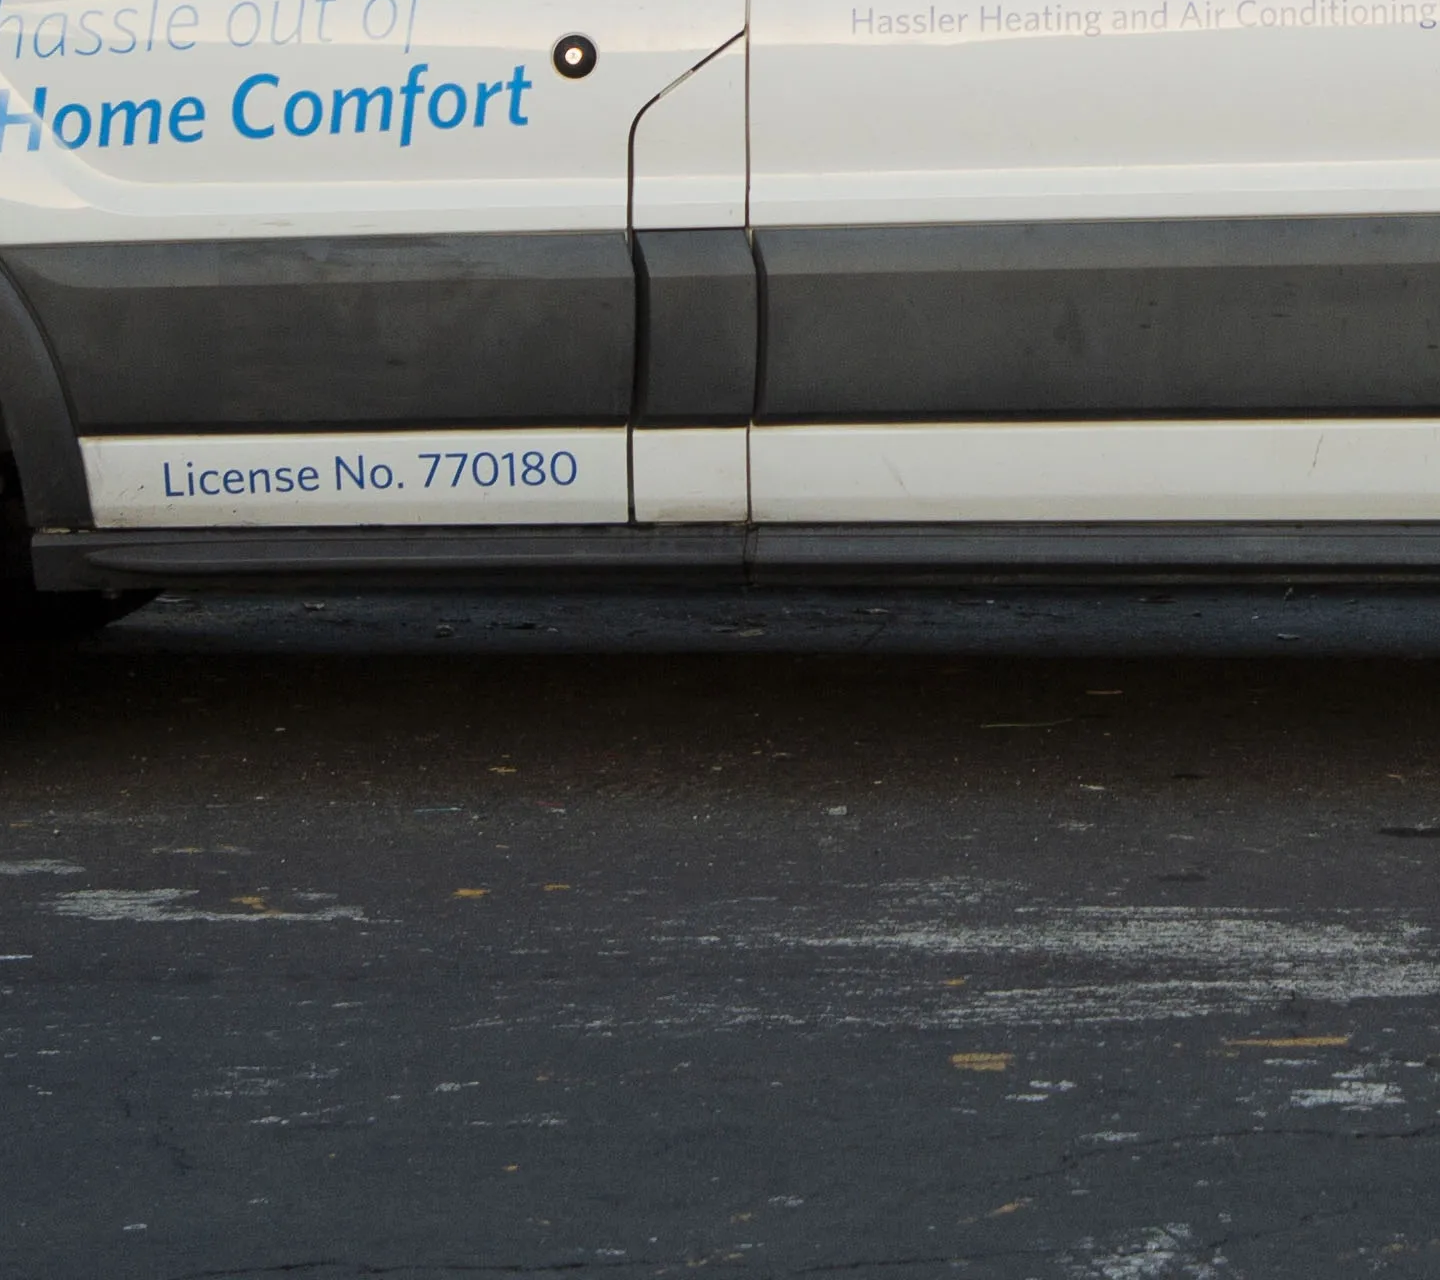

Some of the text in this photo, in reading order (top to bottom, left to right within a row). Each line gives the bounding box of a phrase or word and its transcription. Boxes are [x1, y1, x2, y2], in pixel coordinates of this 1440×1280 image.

[851, 3, 969, 36] Hassler
[980, 2, 1103, 38] Heating
[1112, 0, 1168, 31] and
[231, 63, 532, 148] Comfort
[163, 450, 578, 498] License No. 770180
